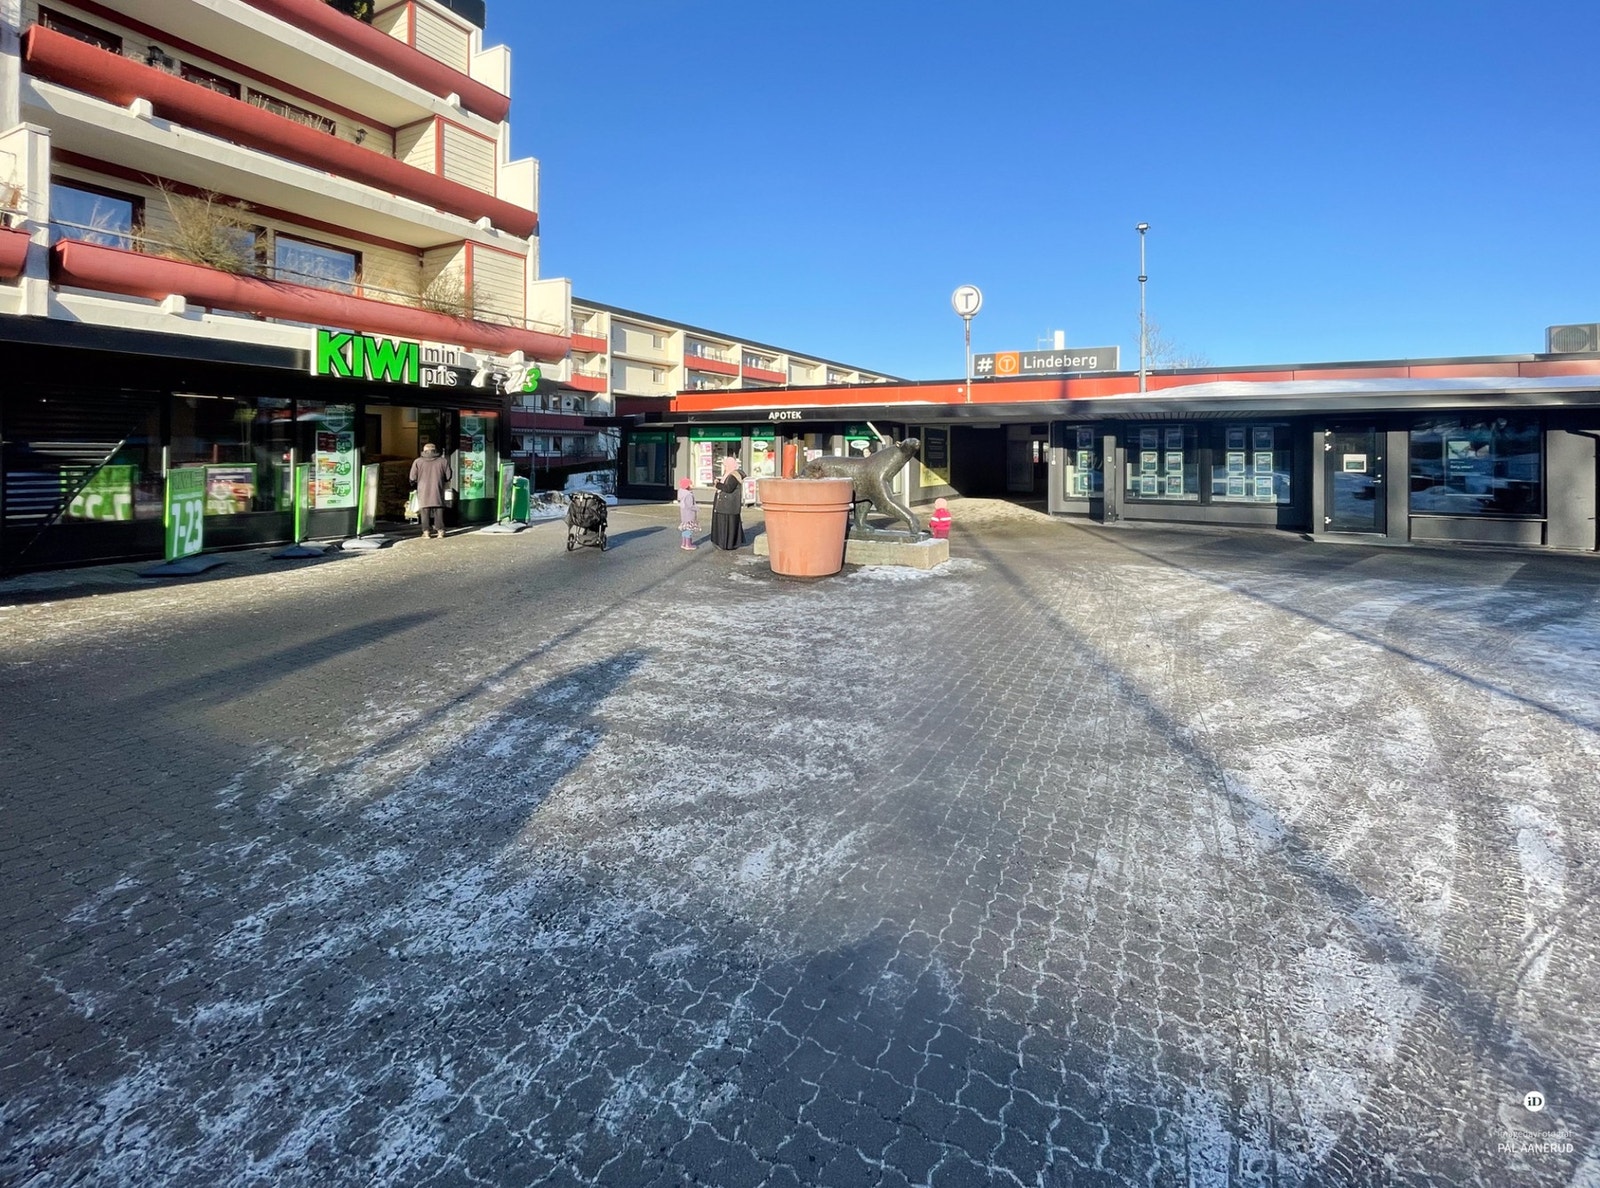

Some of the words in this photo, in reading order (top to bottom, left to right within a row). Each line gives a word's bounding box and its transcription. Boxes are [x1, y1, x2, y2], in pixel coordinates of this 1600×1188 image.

[960, 293, 974, 309] T
[317, 329, 419, 383] KIWI
[424, 346, 461, 365] mini
[1023, 355, 1098, 370] Lindeberg
[424, 366, 458, 387] pris
[768, 411, 802, 420] APOTEK
[171, 499, 203, 558] 7-23
